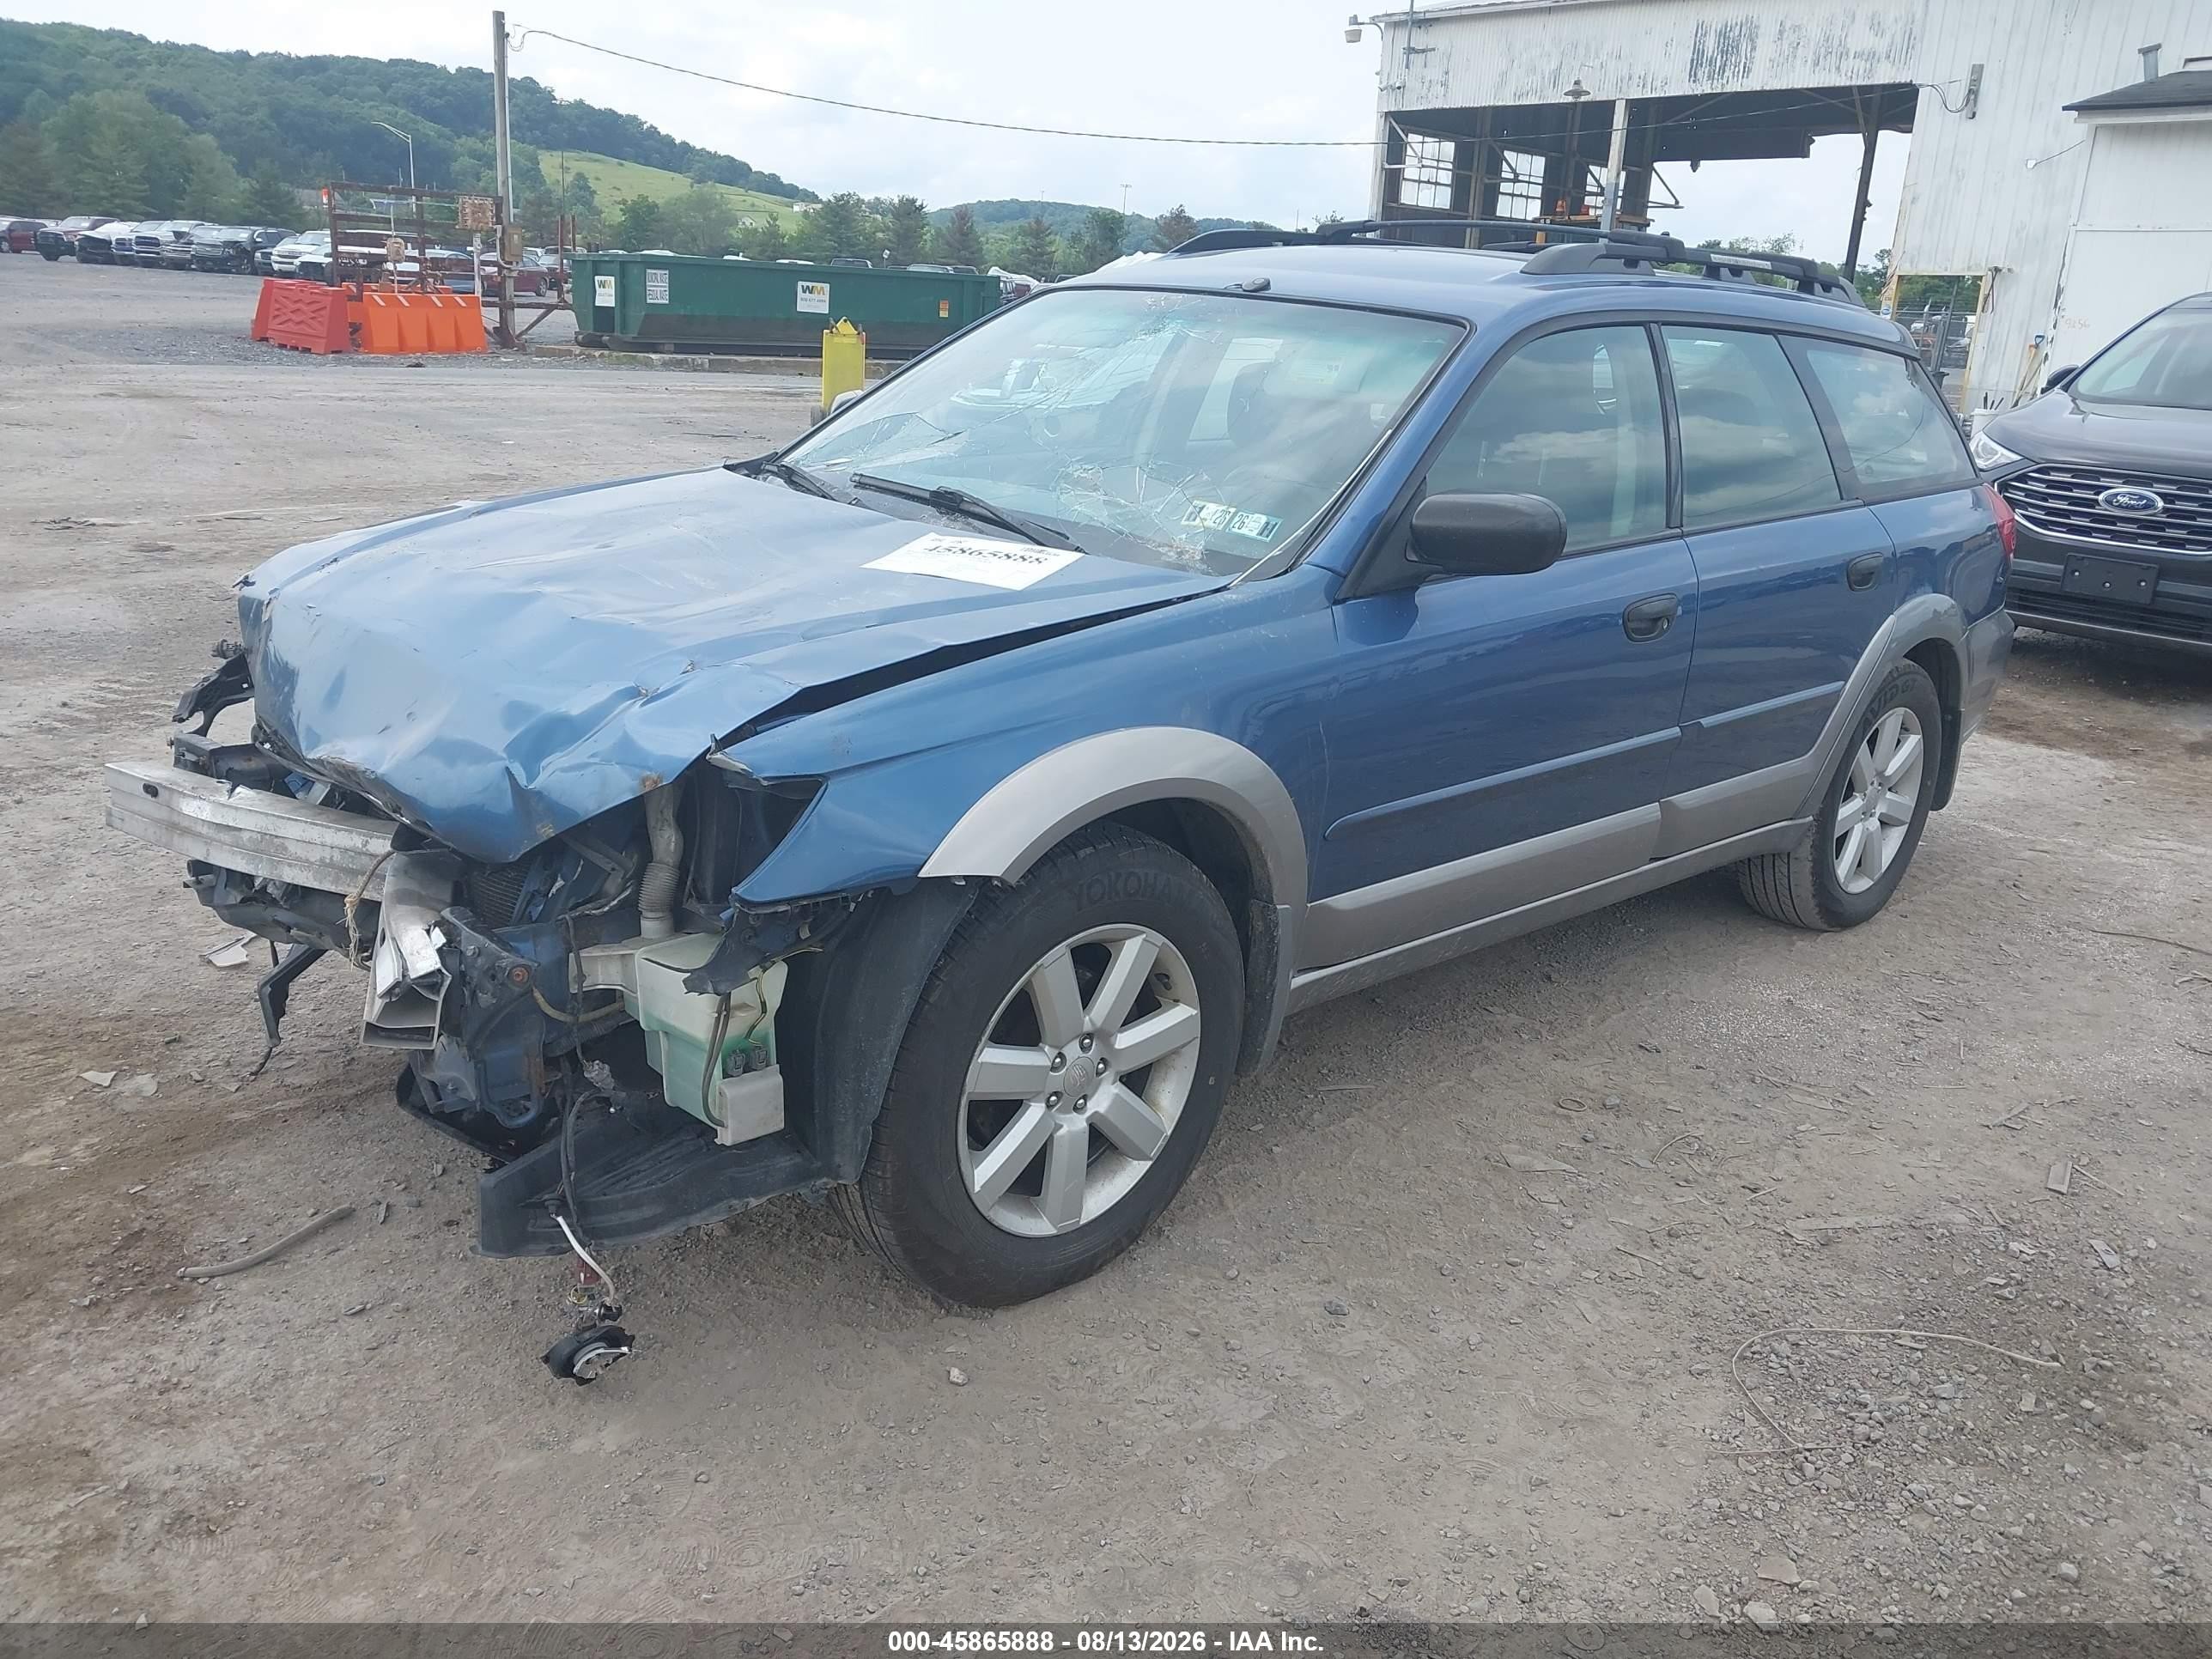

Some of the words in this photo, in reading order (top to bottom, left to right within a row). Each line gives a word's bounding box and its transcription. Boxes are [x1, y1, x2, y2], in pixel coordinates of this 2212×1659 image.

[597, 279, 612, 289] WM
[801, 284, 825, 295] WM
[2112, 493, 2147, 508] Ford
[1231, 514, 1249, 530] 26
